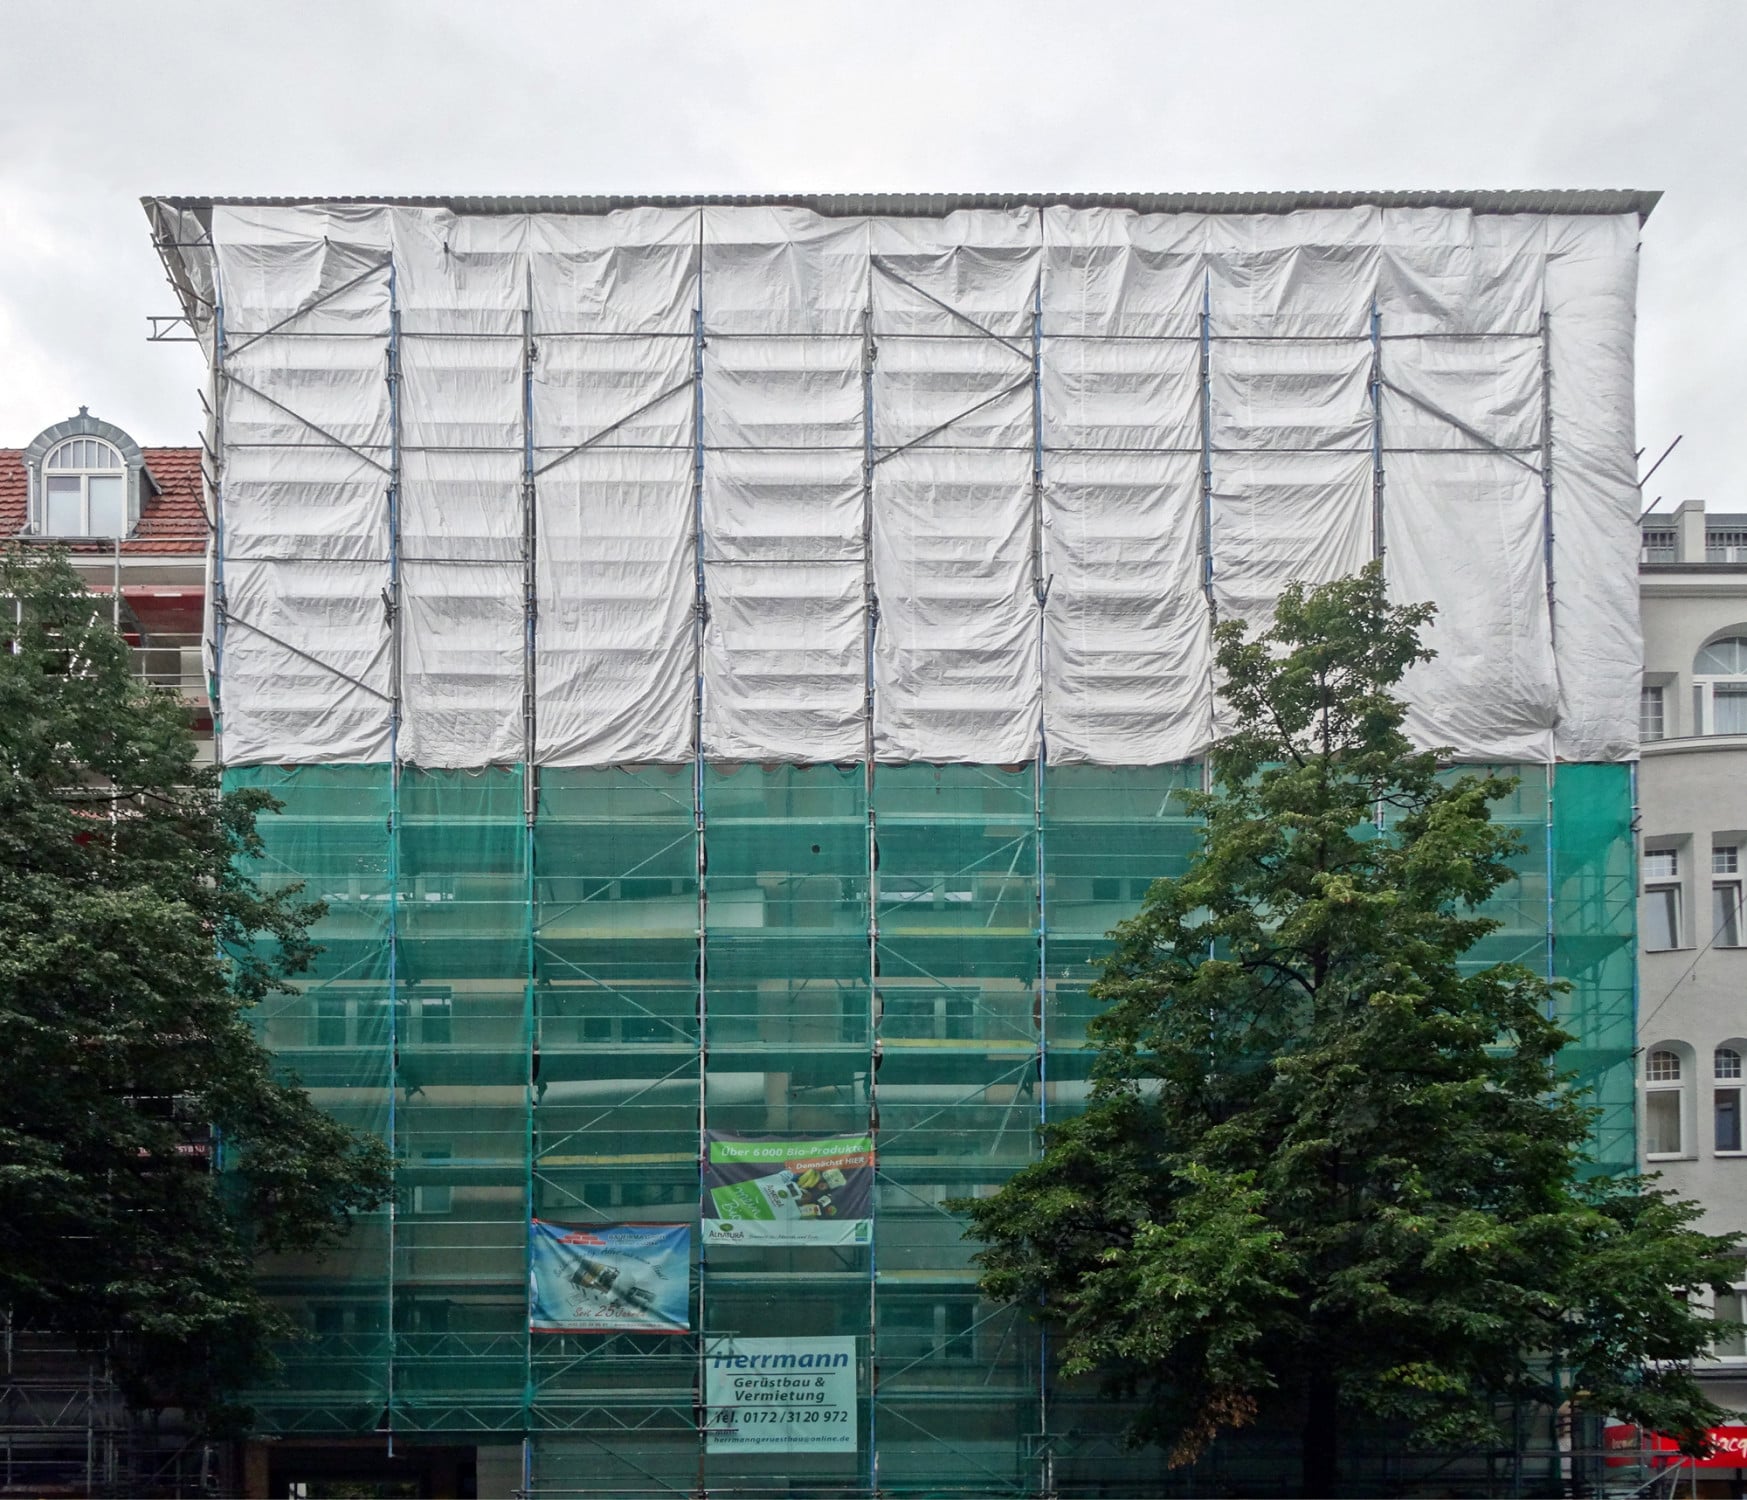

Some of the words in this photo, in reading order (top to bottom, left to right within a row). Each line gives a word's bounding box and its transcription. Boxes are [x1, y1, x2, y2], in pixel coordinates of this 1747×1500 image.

[721, 1145, 749, 1157] Über
[787, 1144, 864, 1157] Bio-Produkte
[796, 1159, 843, 1170] Demnächst
[845, 1156, 865, 1165] HIER
[594, 1303, 615, 1318] 25
[713, 1351, 849, 1369] Herrmann
[733, 1377, 811, 1388] Gerüstbau
[814, 1377, 826, 1388] &
[734, 1390, 825, 1403] Vermietung
[715, 1411, 738, 1423] Tel.
[823, 1411, 848, 1423] 972
